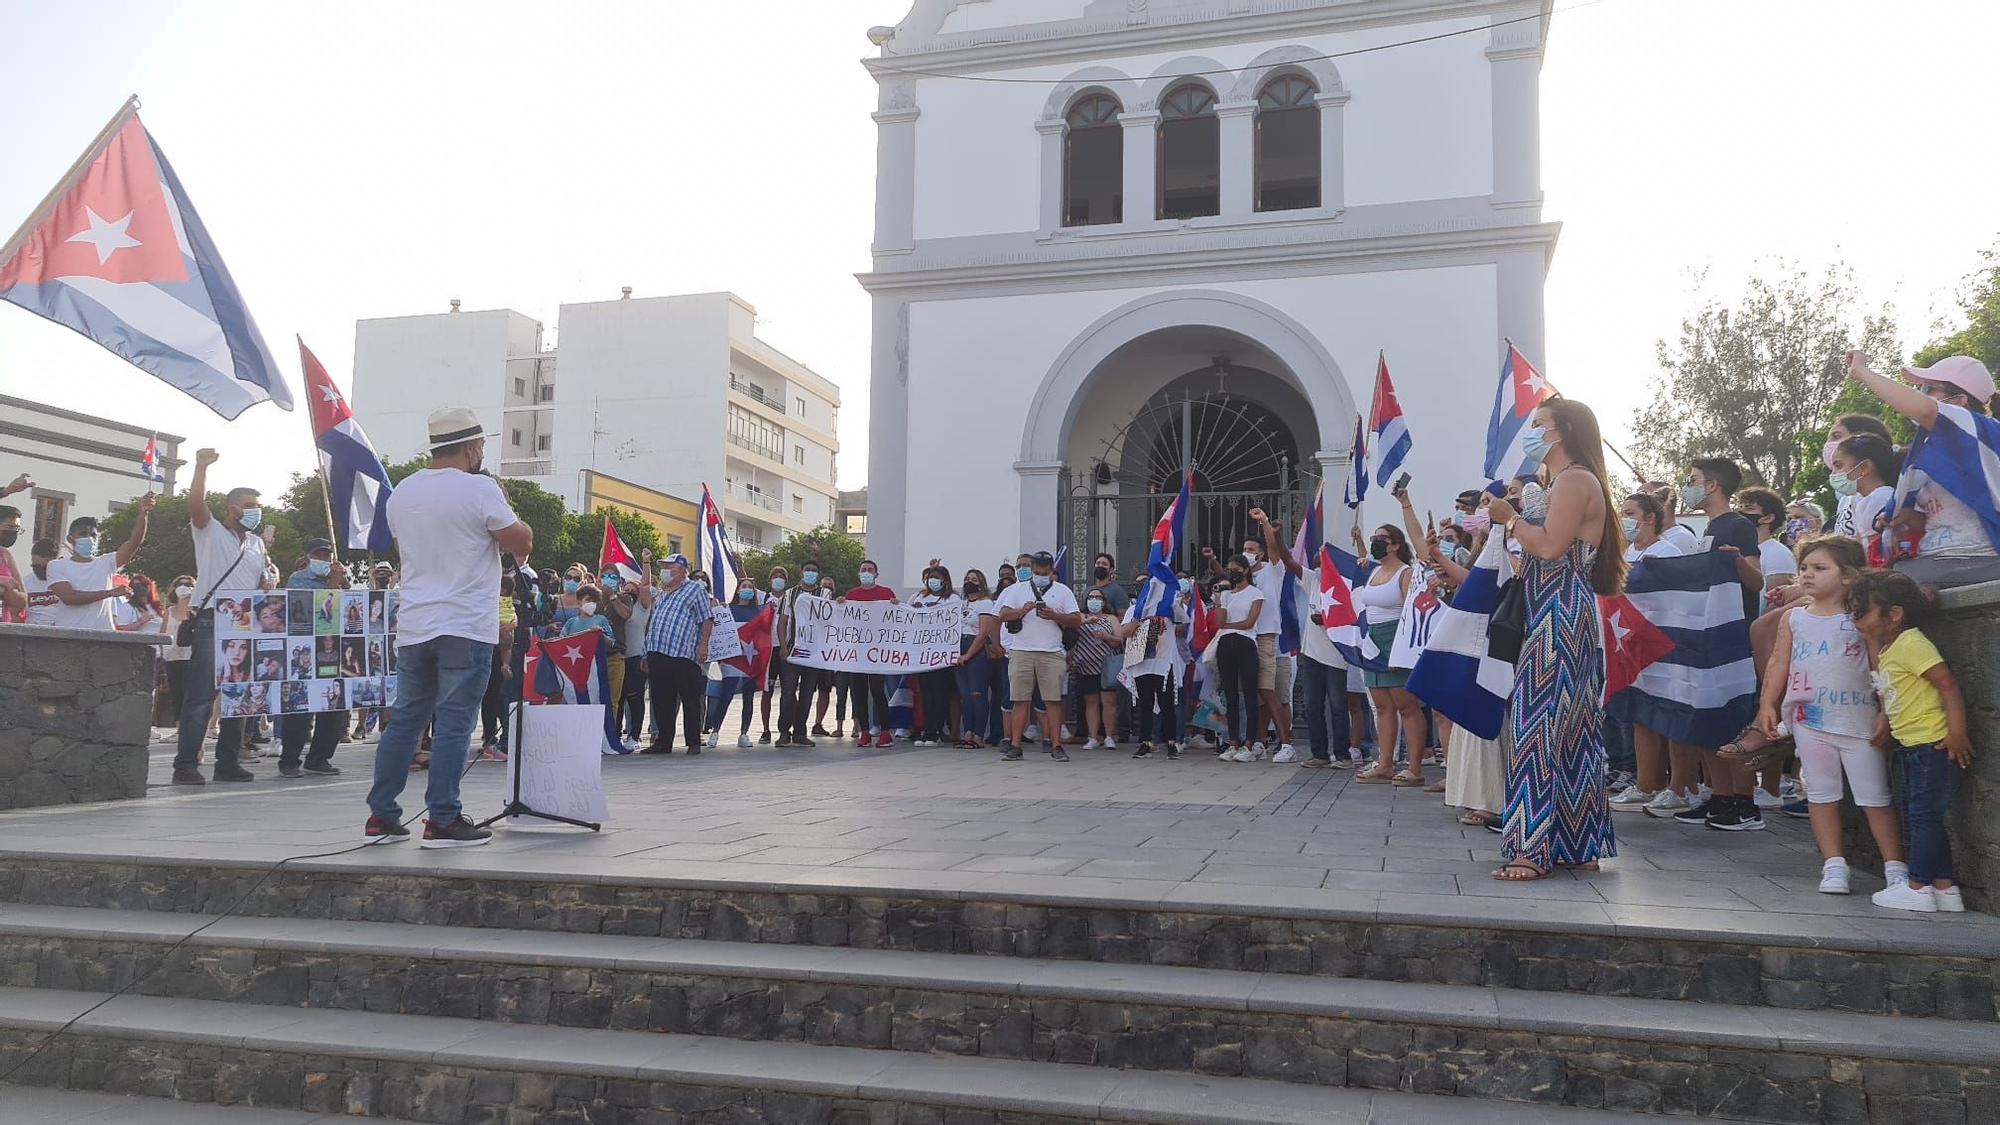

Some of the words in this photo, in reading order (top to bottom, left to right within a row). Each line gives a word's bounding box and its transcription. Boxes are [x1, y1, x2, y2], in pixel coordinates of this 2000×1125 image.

[809, 600, 833, 621] NO
[882, 606, 959, 629] MENTIRAS
[798, 624, 815, 644] MI
[823, 624, 873, 644] PUEBLO
[878, 628, 908, 644] PIDE
[912, 628, 960, 646] LIBERTAD
[821, 644, 858, 662] VIVA
[867, 647, 909, 667] CUBA
[920, 647, 960, 667] LIBRE
